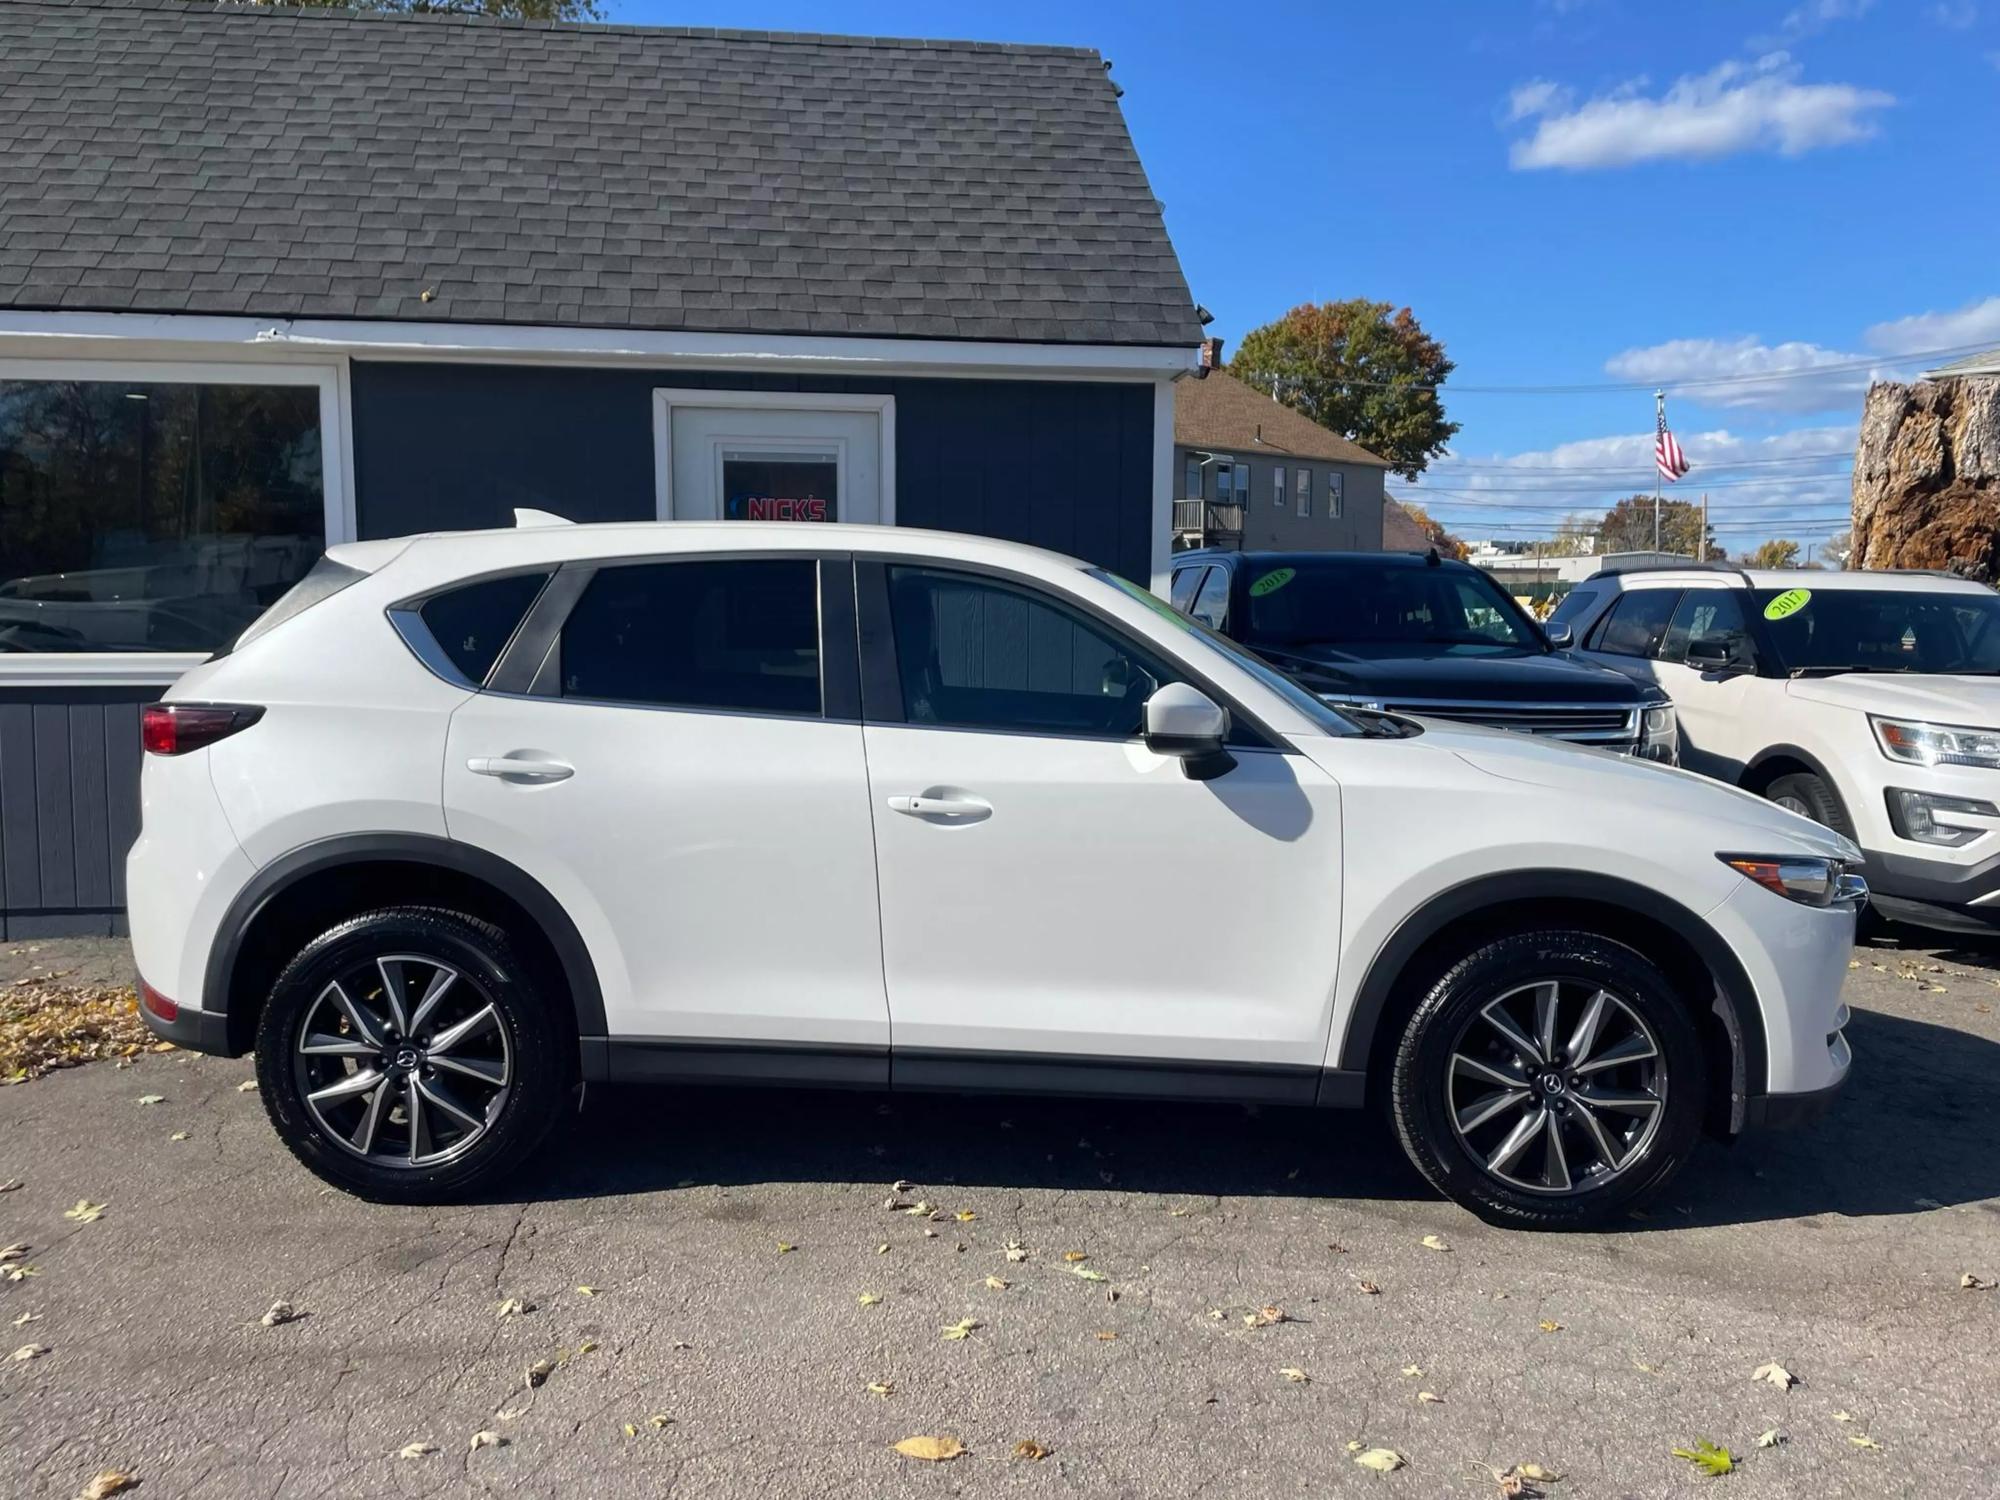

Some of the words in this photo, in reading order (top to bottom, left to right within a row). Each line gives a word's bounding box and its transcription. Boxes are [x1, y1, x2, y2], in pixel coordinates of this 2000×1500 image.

[748, 494, 827, 522] NICK'S
[1258, 570, 1289, 593] 2018
[1771, 590, 1802, 616] 2017
